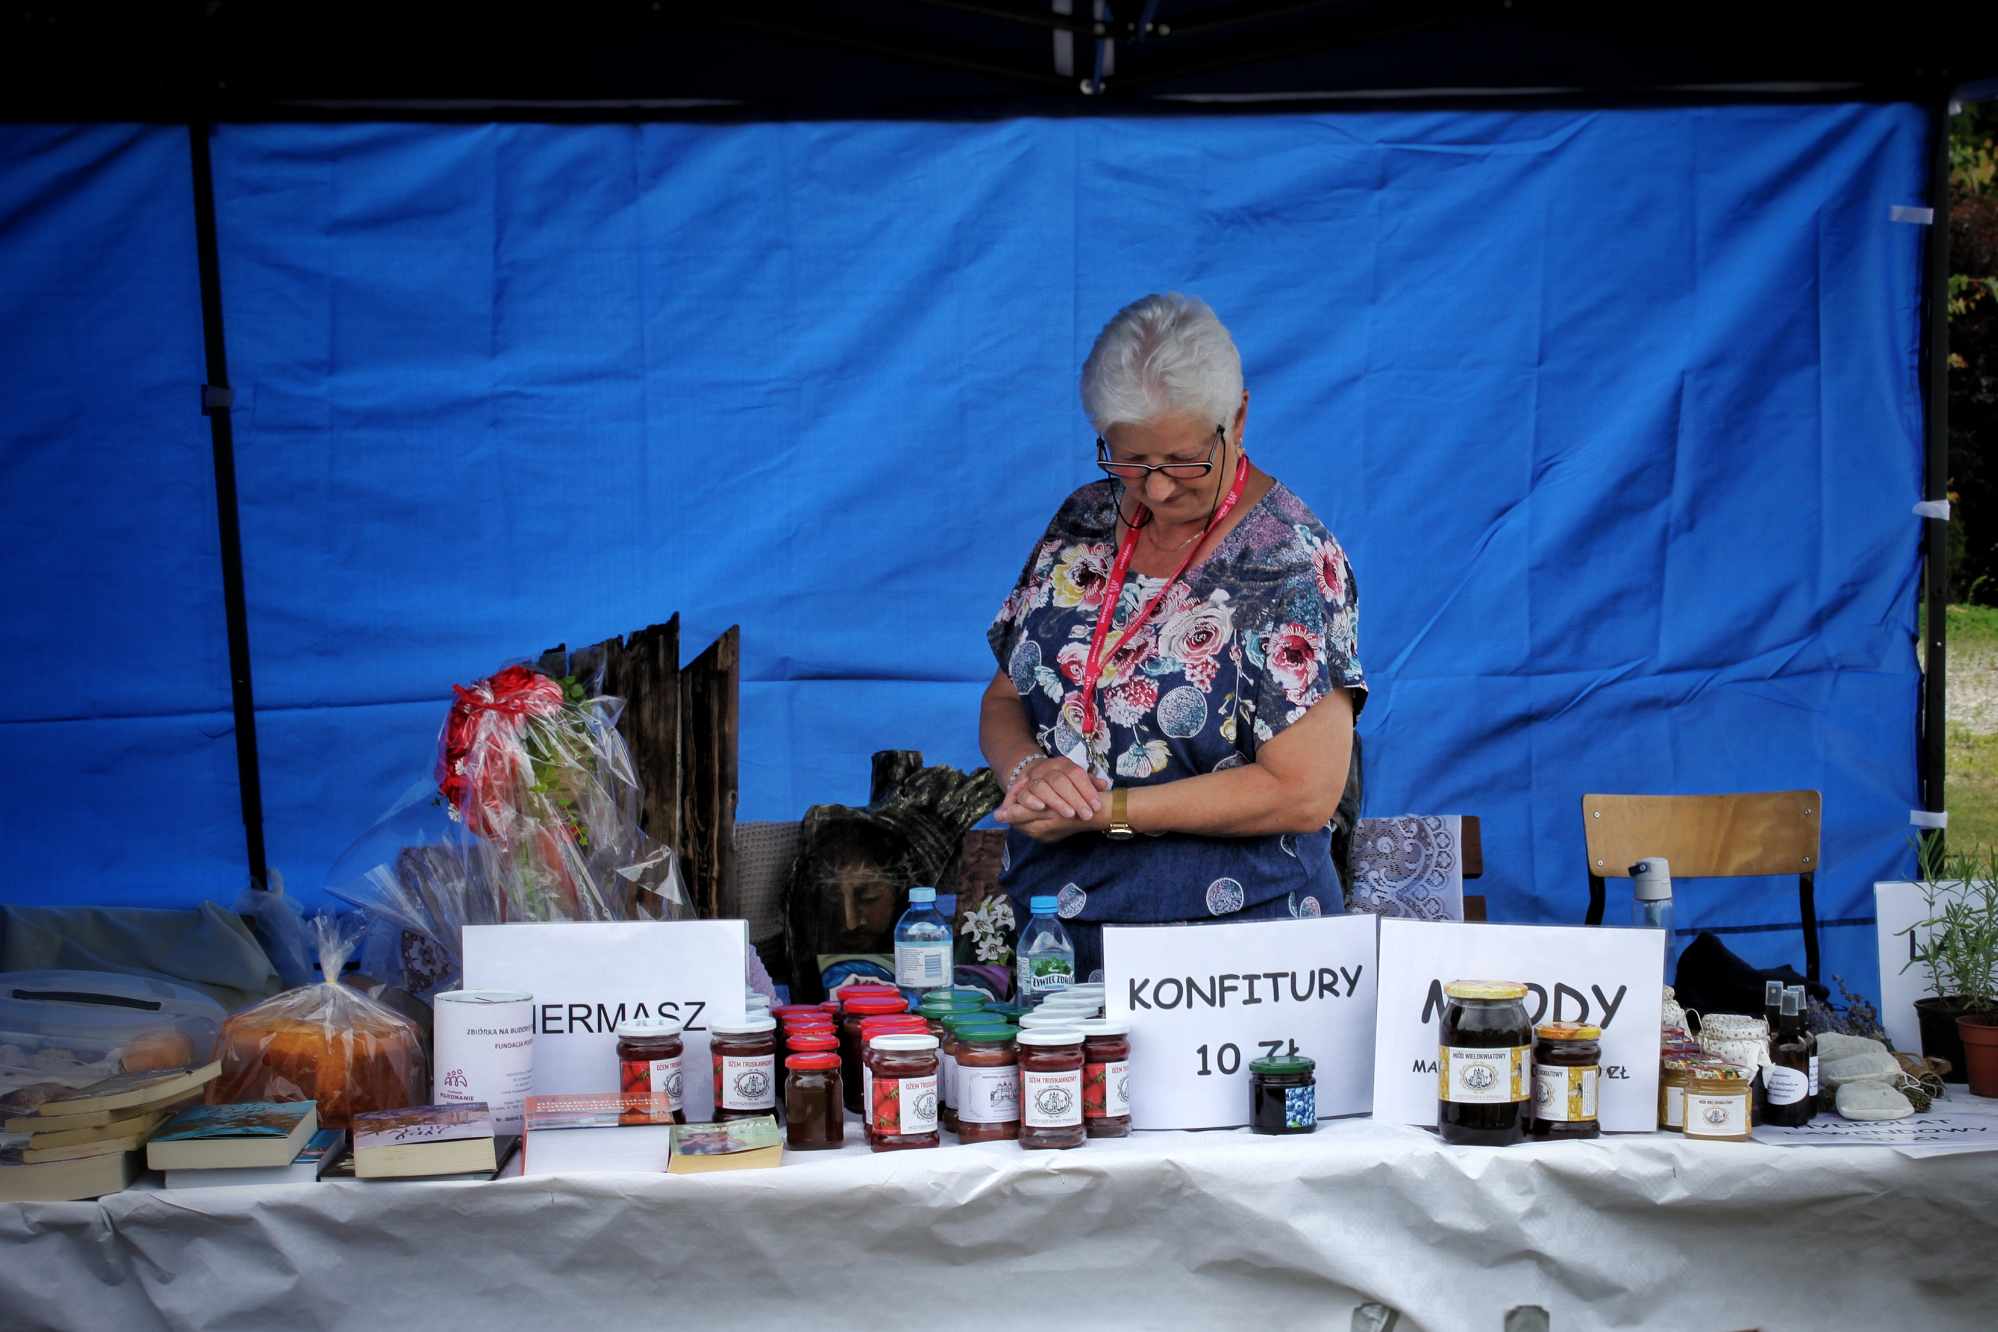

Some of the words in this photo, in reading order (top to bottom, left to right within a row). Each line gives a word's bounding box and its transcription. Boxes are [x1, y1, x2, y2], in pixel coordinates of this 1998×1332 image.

[1129, 964, 1363, 1011] KONFITURY
[1421, 979, 1628, 1030] MODY
[499, 1027, 509, 1035] NA
[532, 1001, 707, 1034] IERMASZ
[1196, 1042, 1242, 1076] 10
